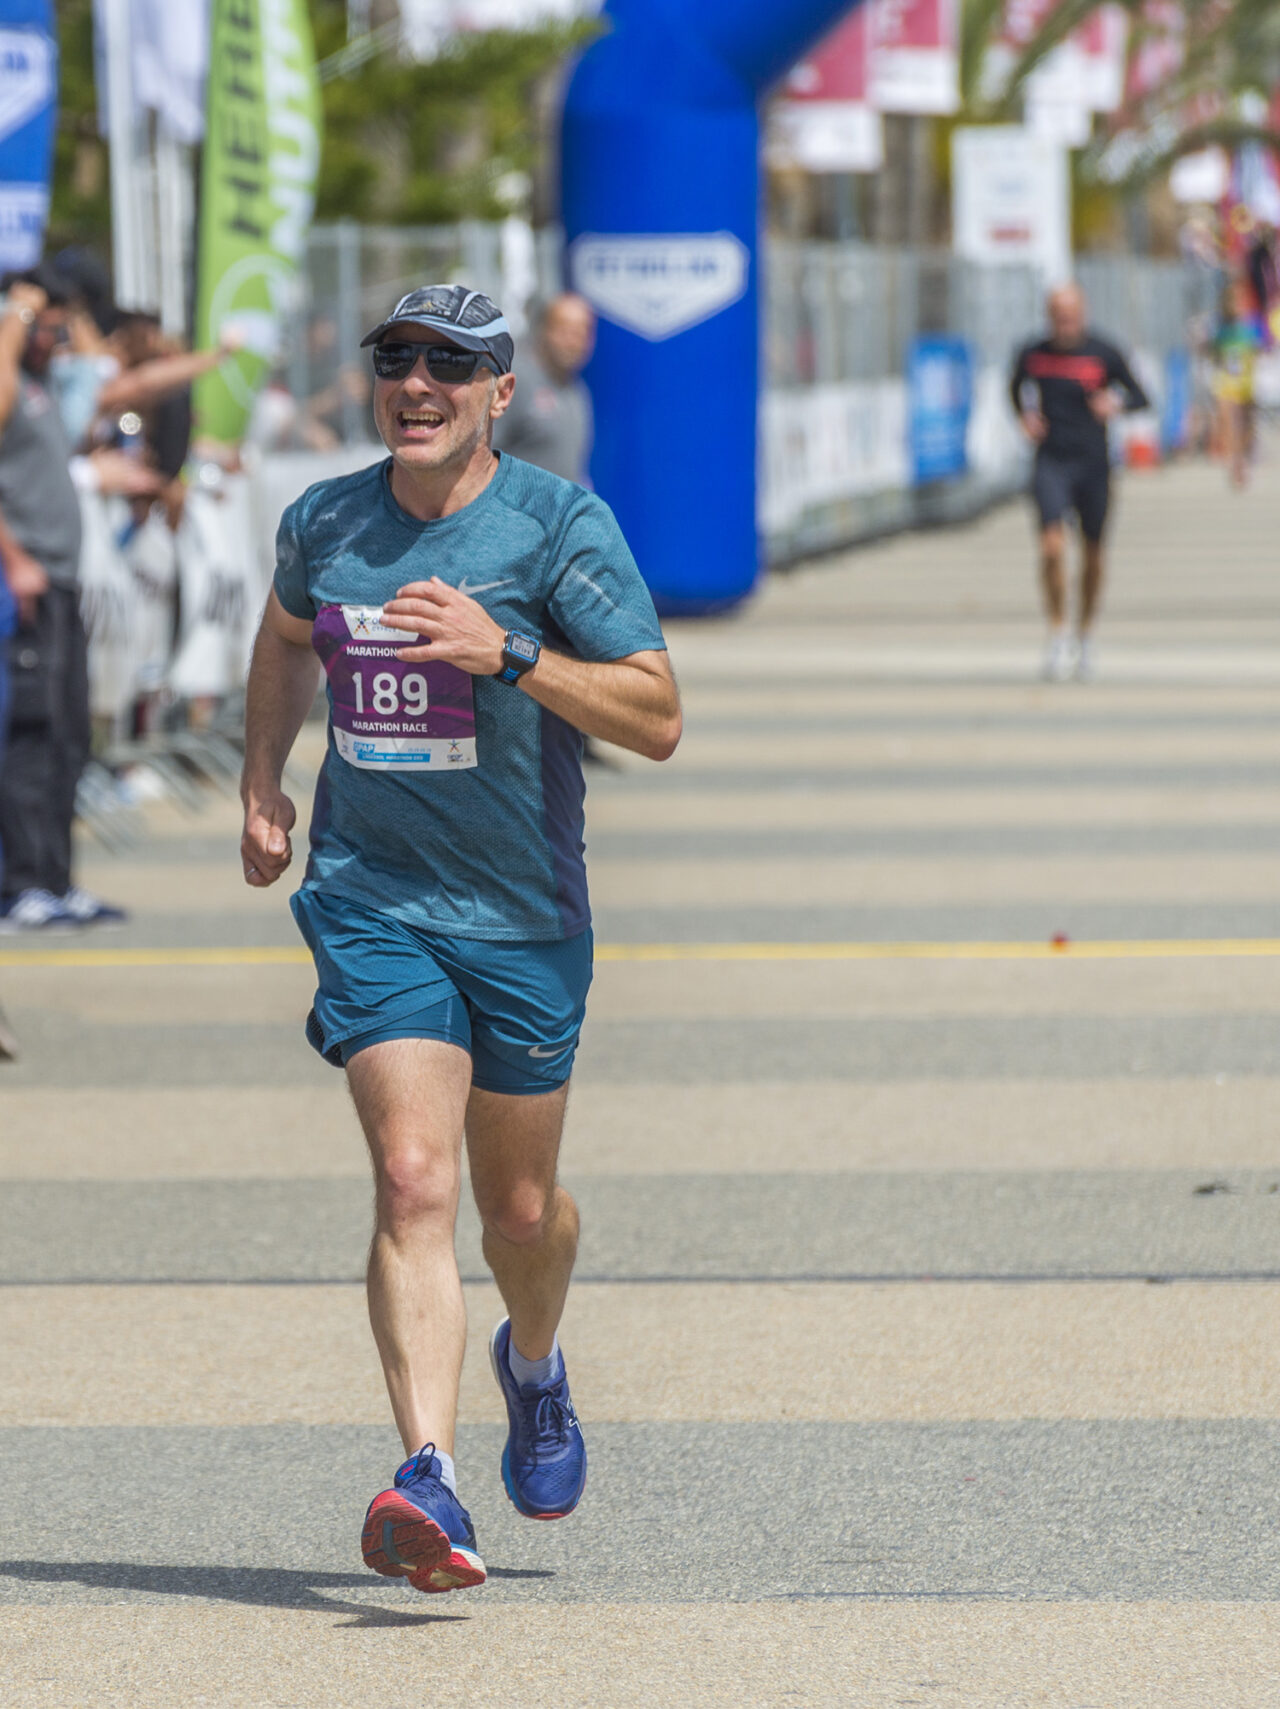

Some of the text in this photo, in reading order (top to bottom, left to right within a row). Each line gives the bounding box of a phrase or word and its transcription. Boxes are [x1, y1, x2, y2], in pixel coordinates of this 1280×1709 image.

[346, 645, 397, 657] MARATHON
[352, 672, 429, 716] 189
[352, 720, 428, 733] MARATHON RACE
